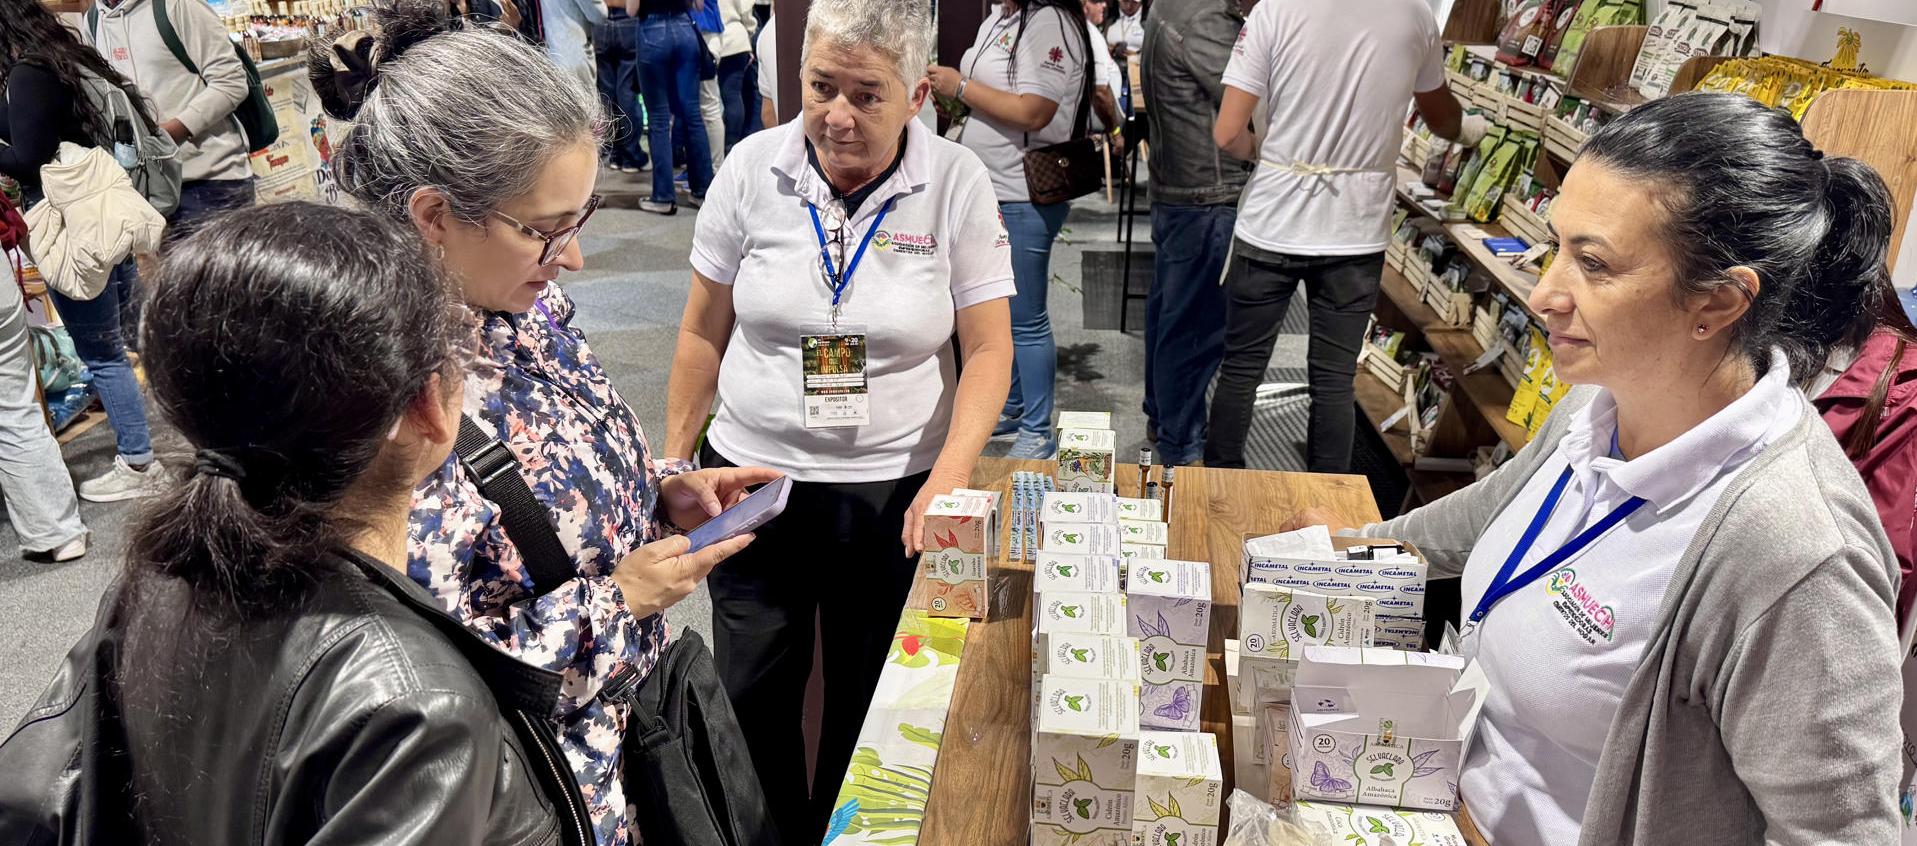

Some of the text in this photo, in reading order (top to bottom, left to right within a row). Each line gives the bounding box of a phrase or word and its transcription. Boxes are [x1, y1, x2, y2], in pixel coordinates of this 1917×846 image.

[1195, 602, 1206, 619] 20g
[1363, 601, 1372, 613] 20g
[1576, 627, 1596, 645] HOGAR
[1250, 638, 1257, 648] 20
[1318, 738, 1331, 746] 20
[1121, 743, 1134, 760] 20g
[1207, 782, 1219, 798] 20g
[1361, 791, 1397, 799] Amazónica
[1434, 798, 1451, 807] 20g
